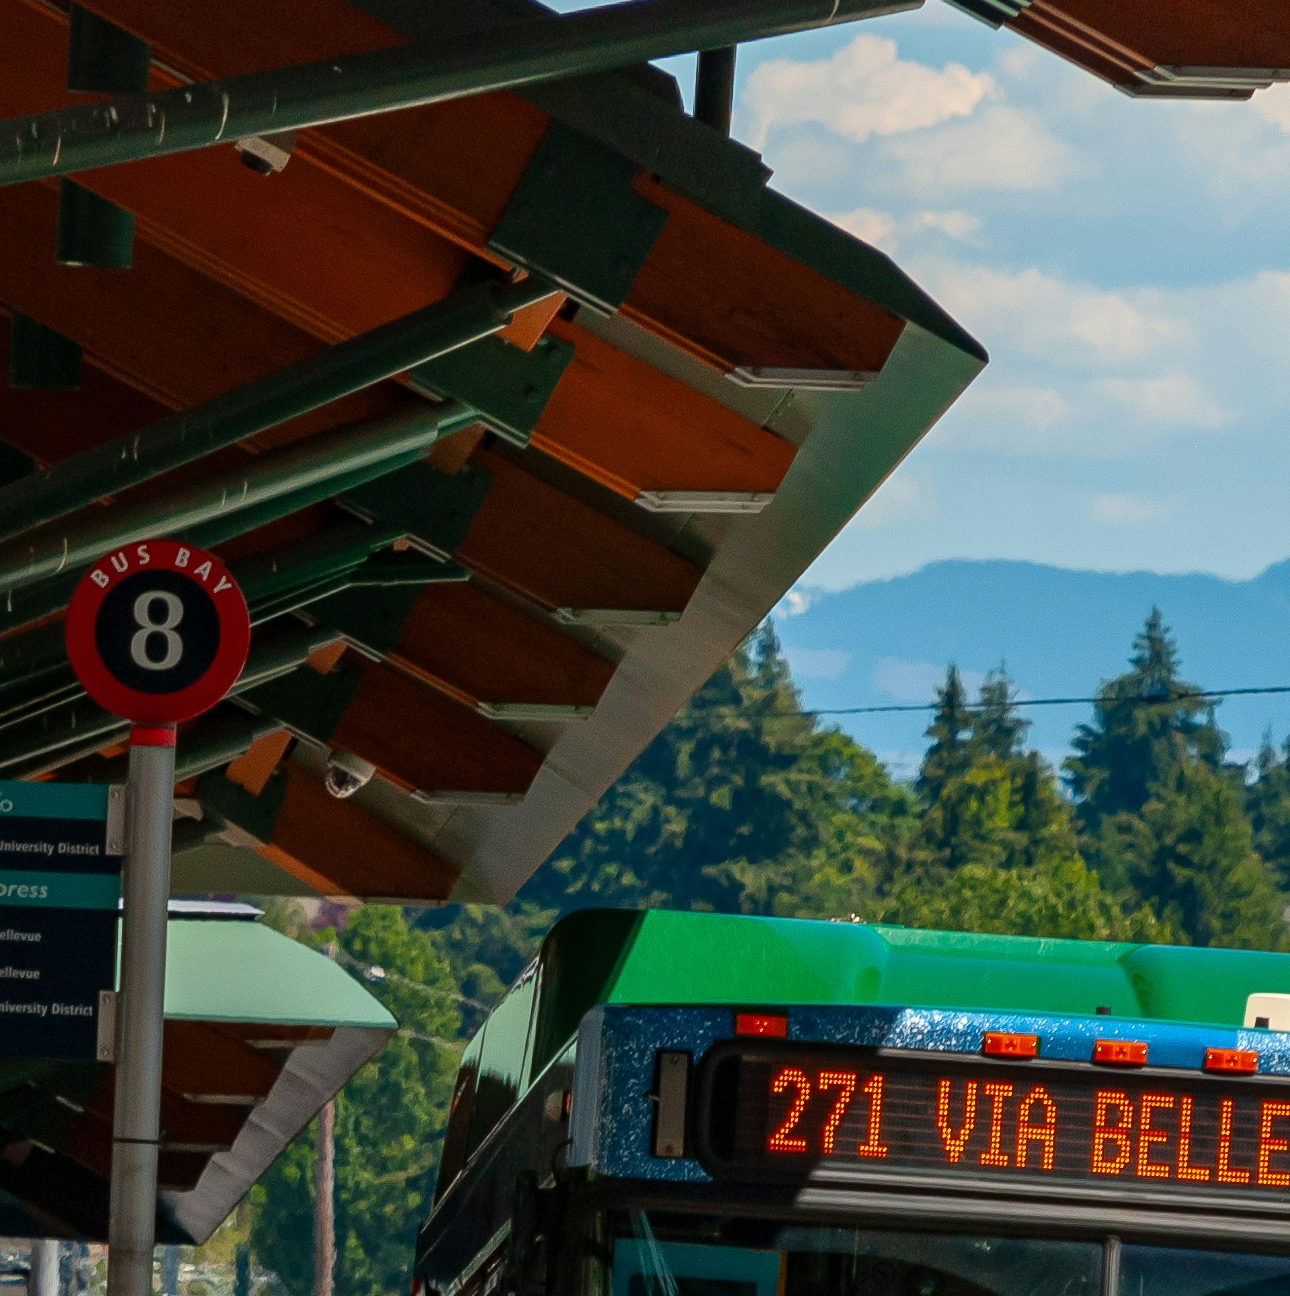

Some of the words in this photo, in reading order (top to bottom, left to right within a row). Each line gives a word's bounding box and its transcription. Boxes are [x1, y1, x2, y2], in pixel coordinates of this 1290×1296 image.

[90, 545, 150, 588] BUS
[175, 547, 233, 593] BAY
[131, 590, 184, 671] 8
[59, 843, 100, 855] District
[51, 1003, 93, 1016] District
[766, 1066, 889, 1159] 271
[935, 1077, 1058, 1171] VIA
